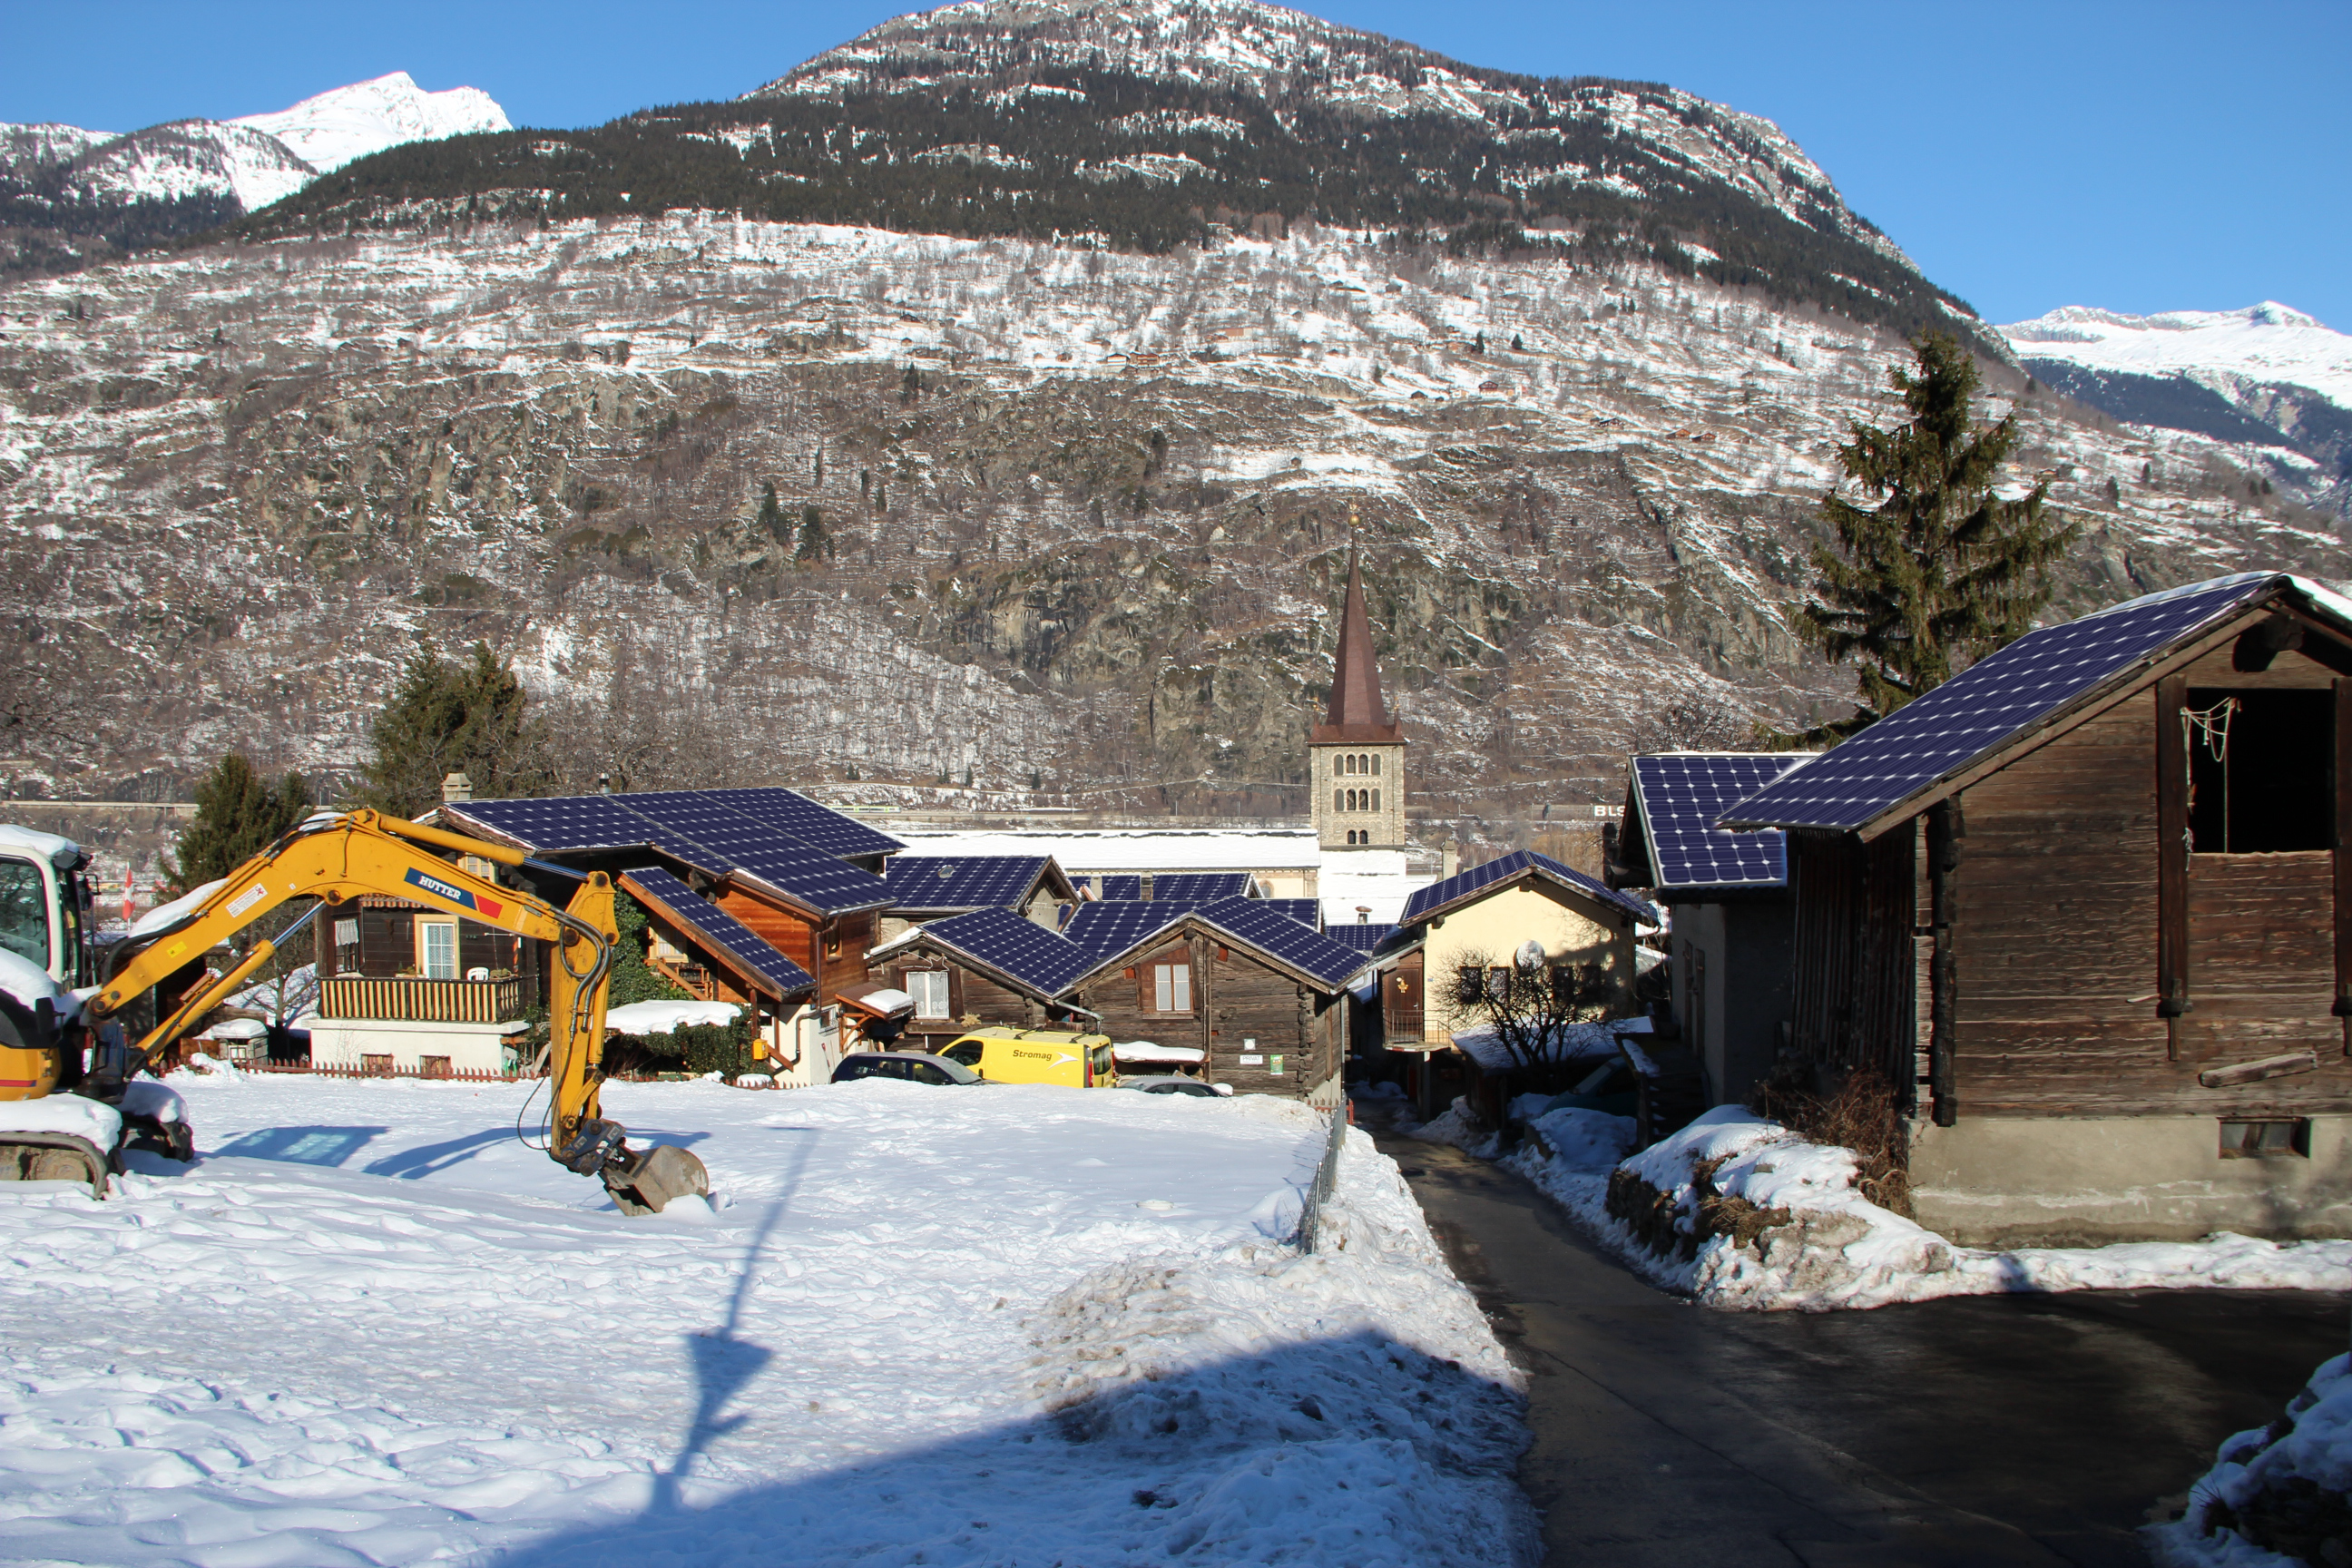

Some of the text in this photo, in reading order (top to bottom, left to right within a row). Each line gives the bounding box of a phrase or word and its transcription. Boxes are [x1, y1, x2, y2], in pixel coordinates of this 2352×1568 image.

[1594, 805, 1625, 817] BLS
[418, 875, 462, 900] HUTTER
[1013, 1049, 1053, 1062] Stromag
